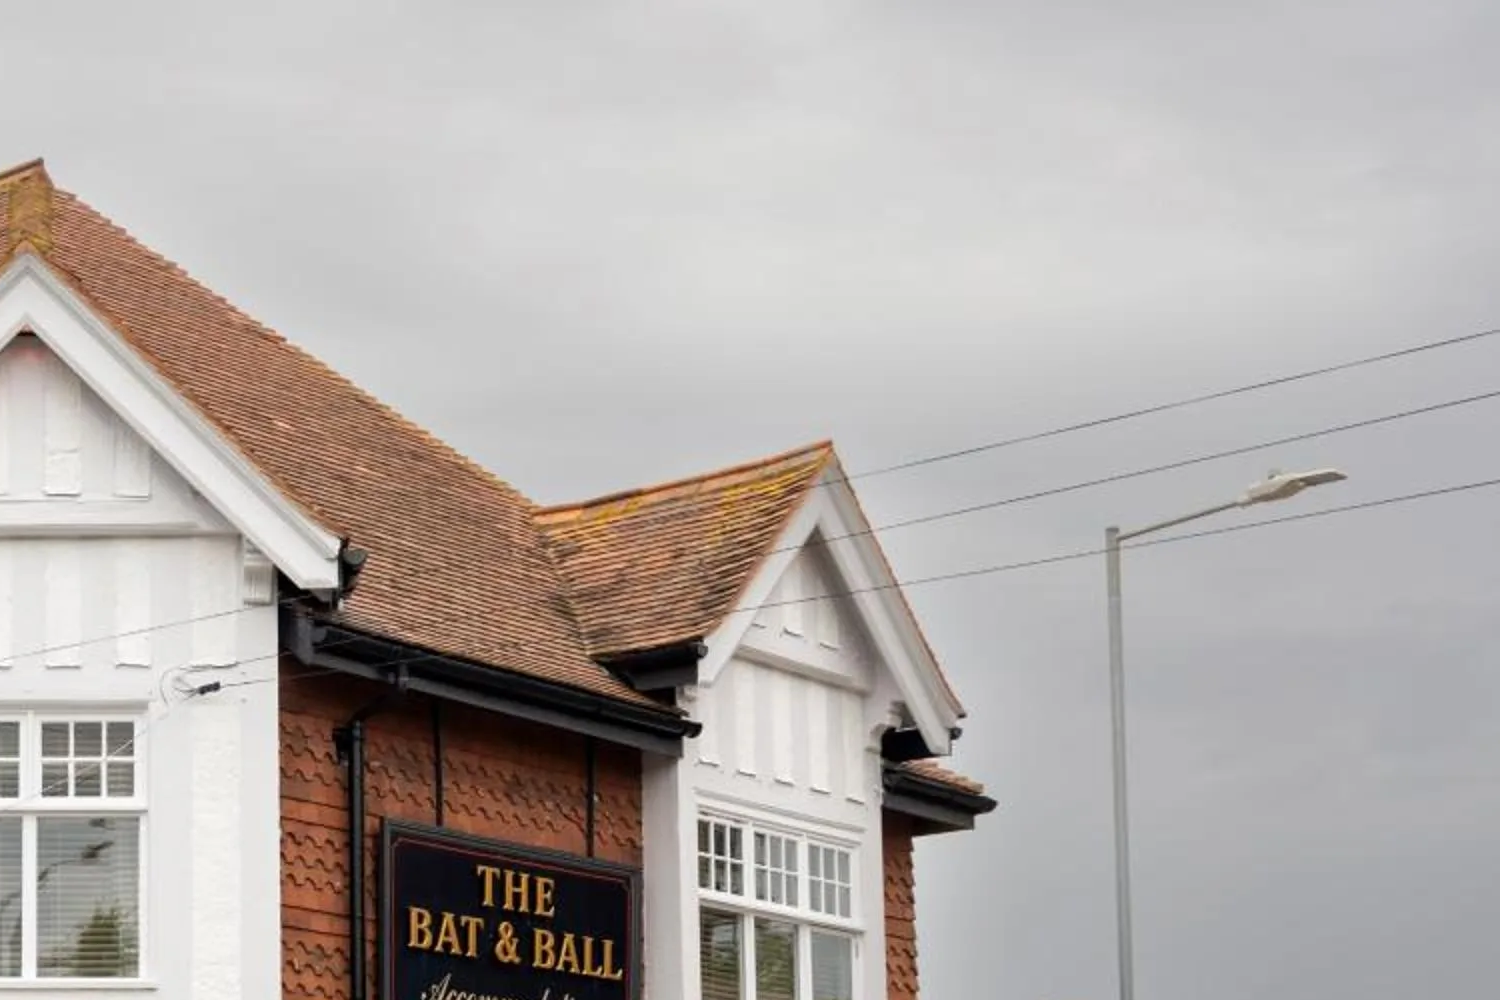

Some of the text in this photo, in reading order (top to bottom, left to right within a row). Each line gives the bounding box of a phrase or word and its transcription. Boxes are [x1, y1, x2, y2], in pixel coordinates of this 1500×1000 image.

[476, 864, 555, 918] THE
[407, 906, 622, 980] BAT & BALL
